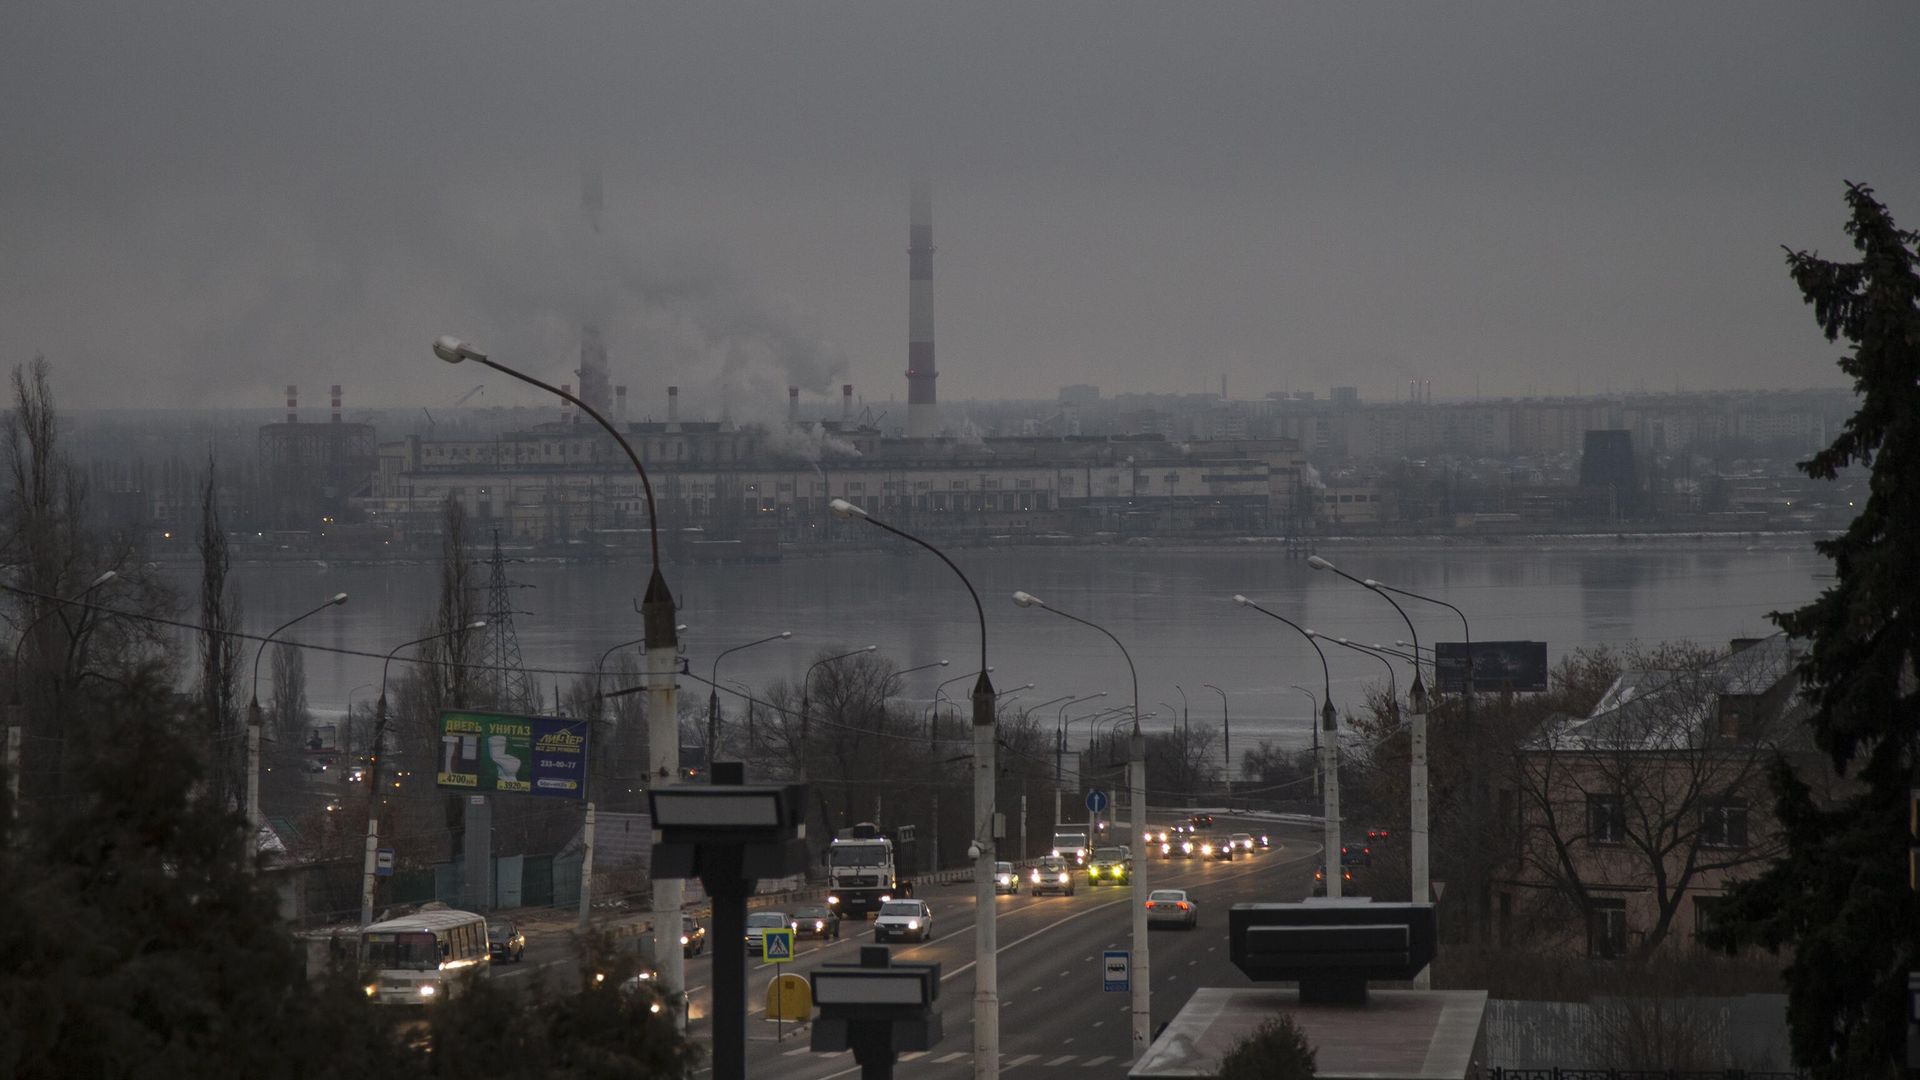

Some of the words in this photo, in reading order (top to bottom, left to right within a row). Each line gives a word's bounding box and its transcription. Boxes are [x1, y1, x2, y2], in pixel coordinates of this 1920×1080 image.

[445, 719, 482, 732] ДВЕРЬ
[489, 722, 531, 735] УНИТАЗ
[447, 773, 466, 783] 4700
[504, 781, 521, 790] 3920
